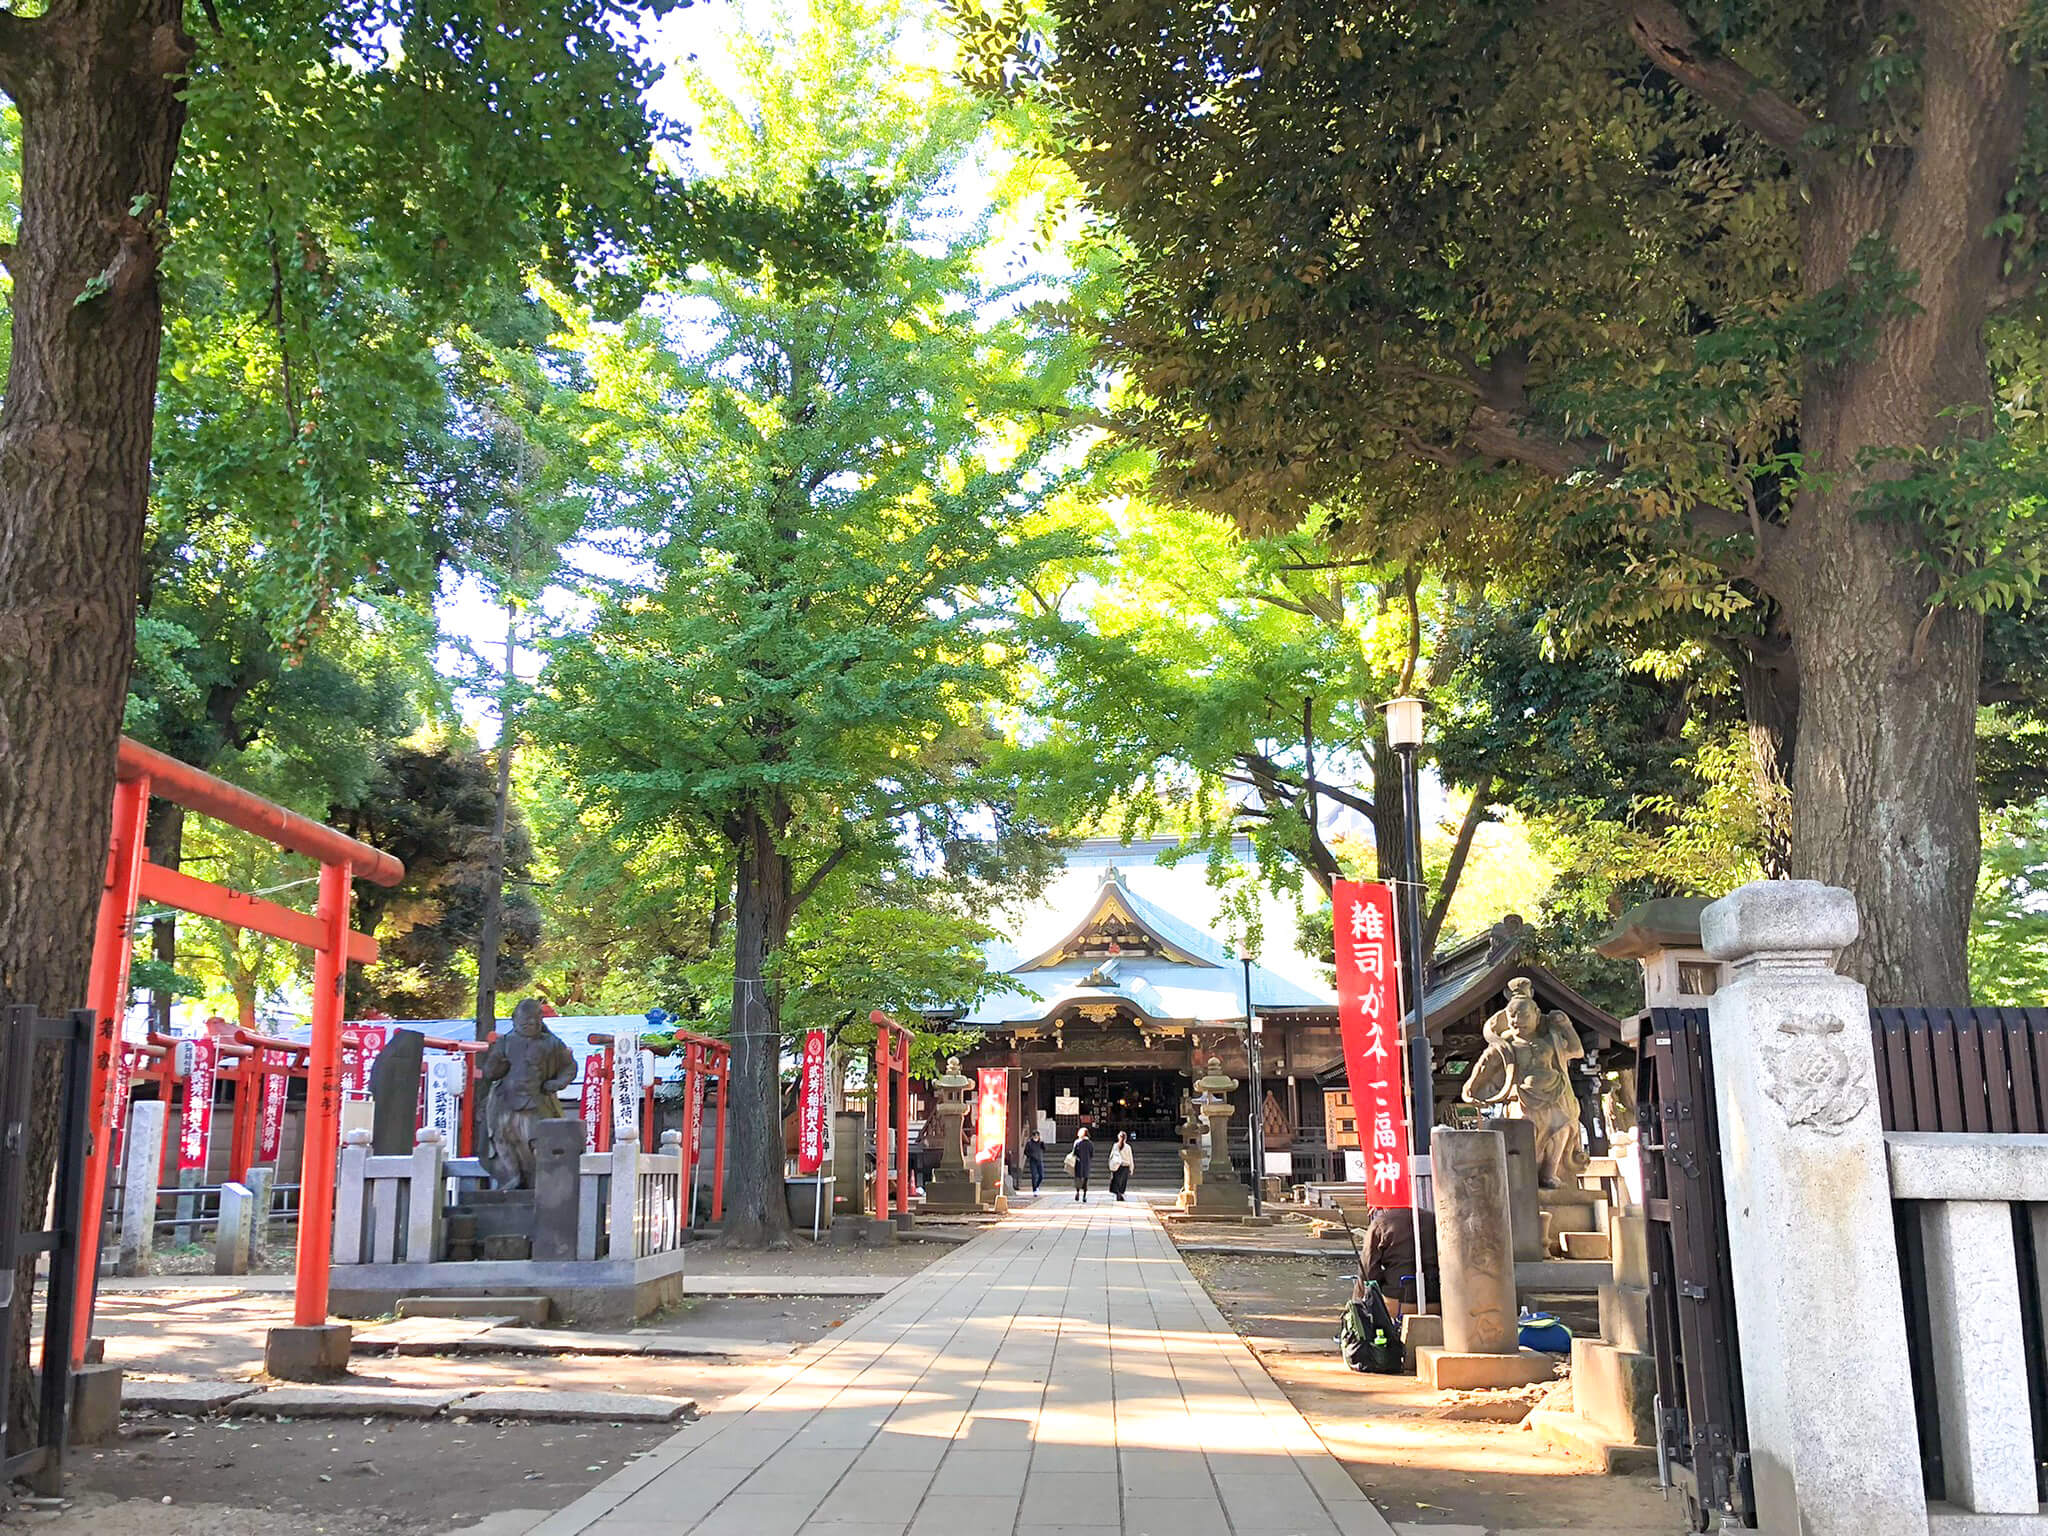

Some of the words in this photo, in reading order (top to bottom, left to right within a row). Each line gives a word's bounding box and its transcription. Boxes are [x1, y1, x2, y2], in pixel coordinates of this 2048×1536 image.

[806, 1064, 820, 1160] 武芳稲荷大明神
